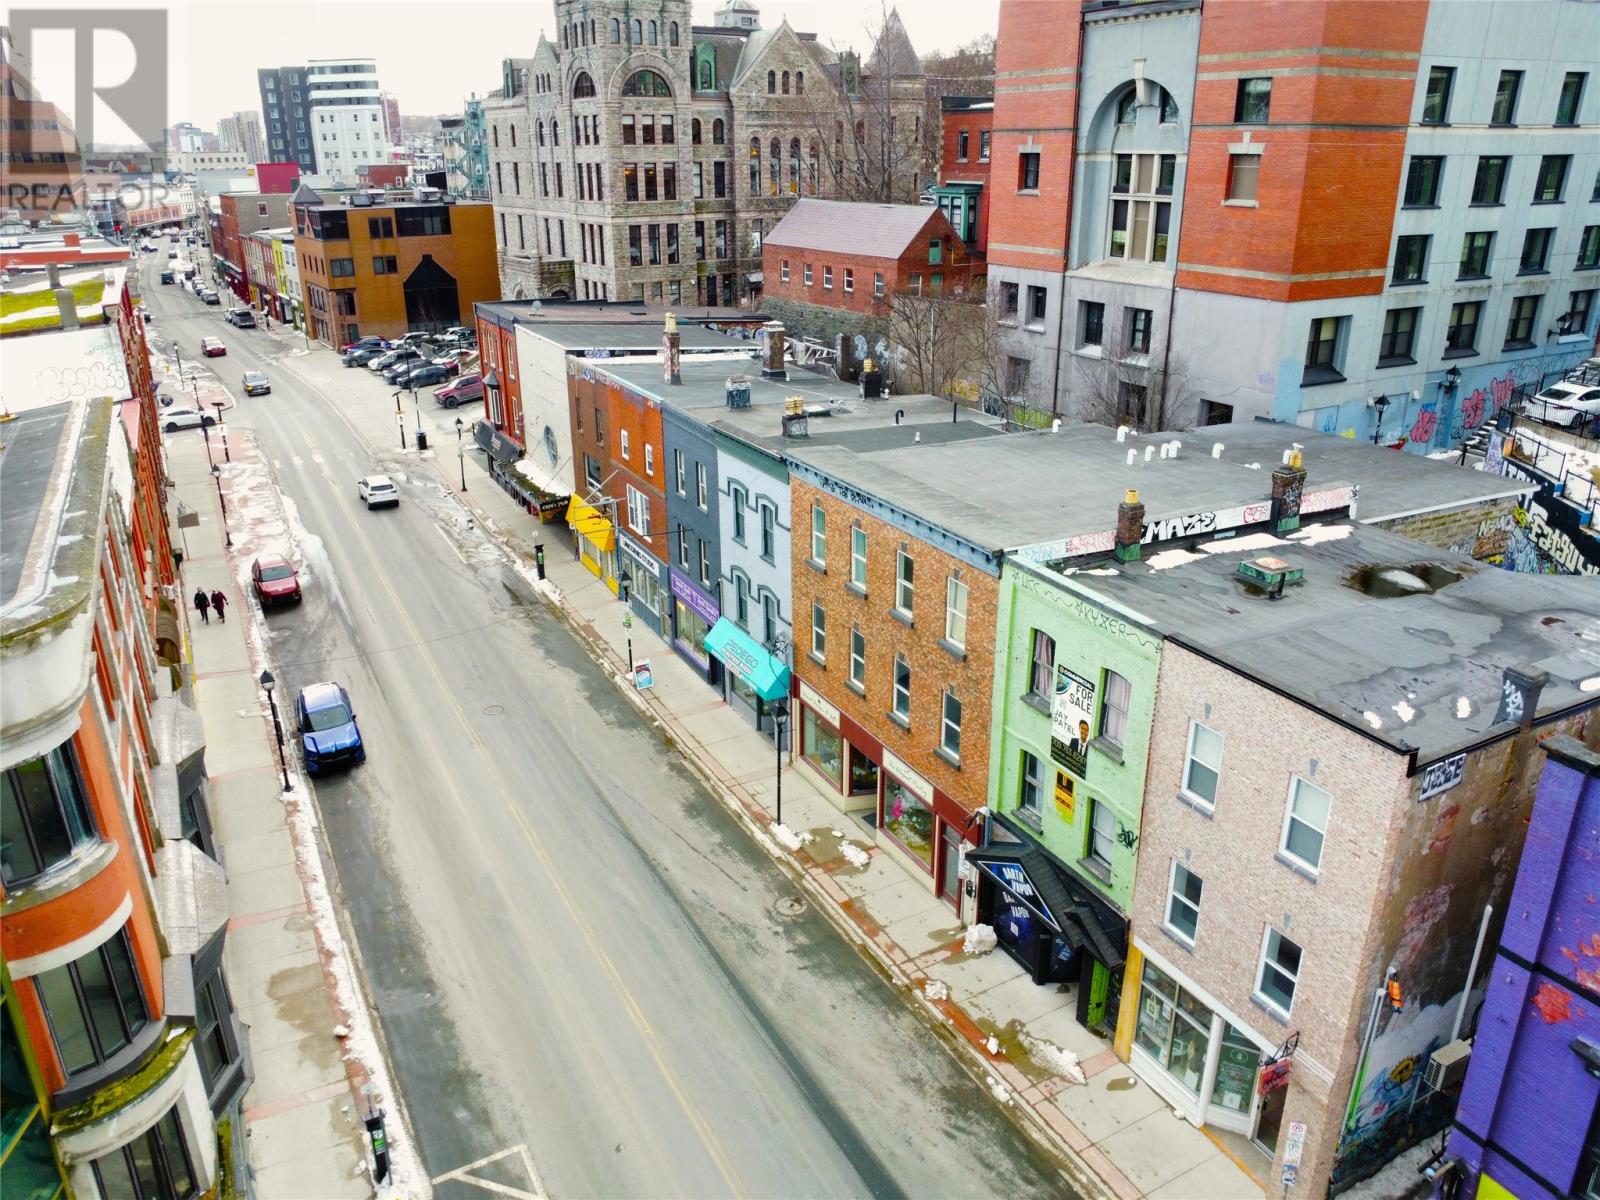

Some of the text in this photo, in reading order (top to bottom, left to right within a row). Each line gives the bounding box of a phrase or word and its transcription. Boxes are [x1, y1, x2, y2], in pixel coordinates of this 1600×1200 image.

[724, 639, 759, 669] PEDEGO
[1076, 684, 1093, 703] FOR
[1069, 693, 1092, 715] SALE
[1055, 709, 1068, 720] JAY
[1053, 716, 1076, 736] PATEL
